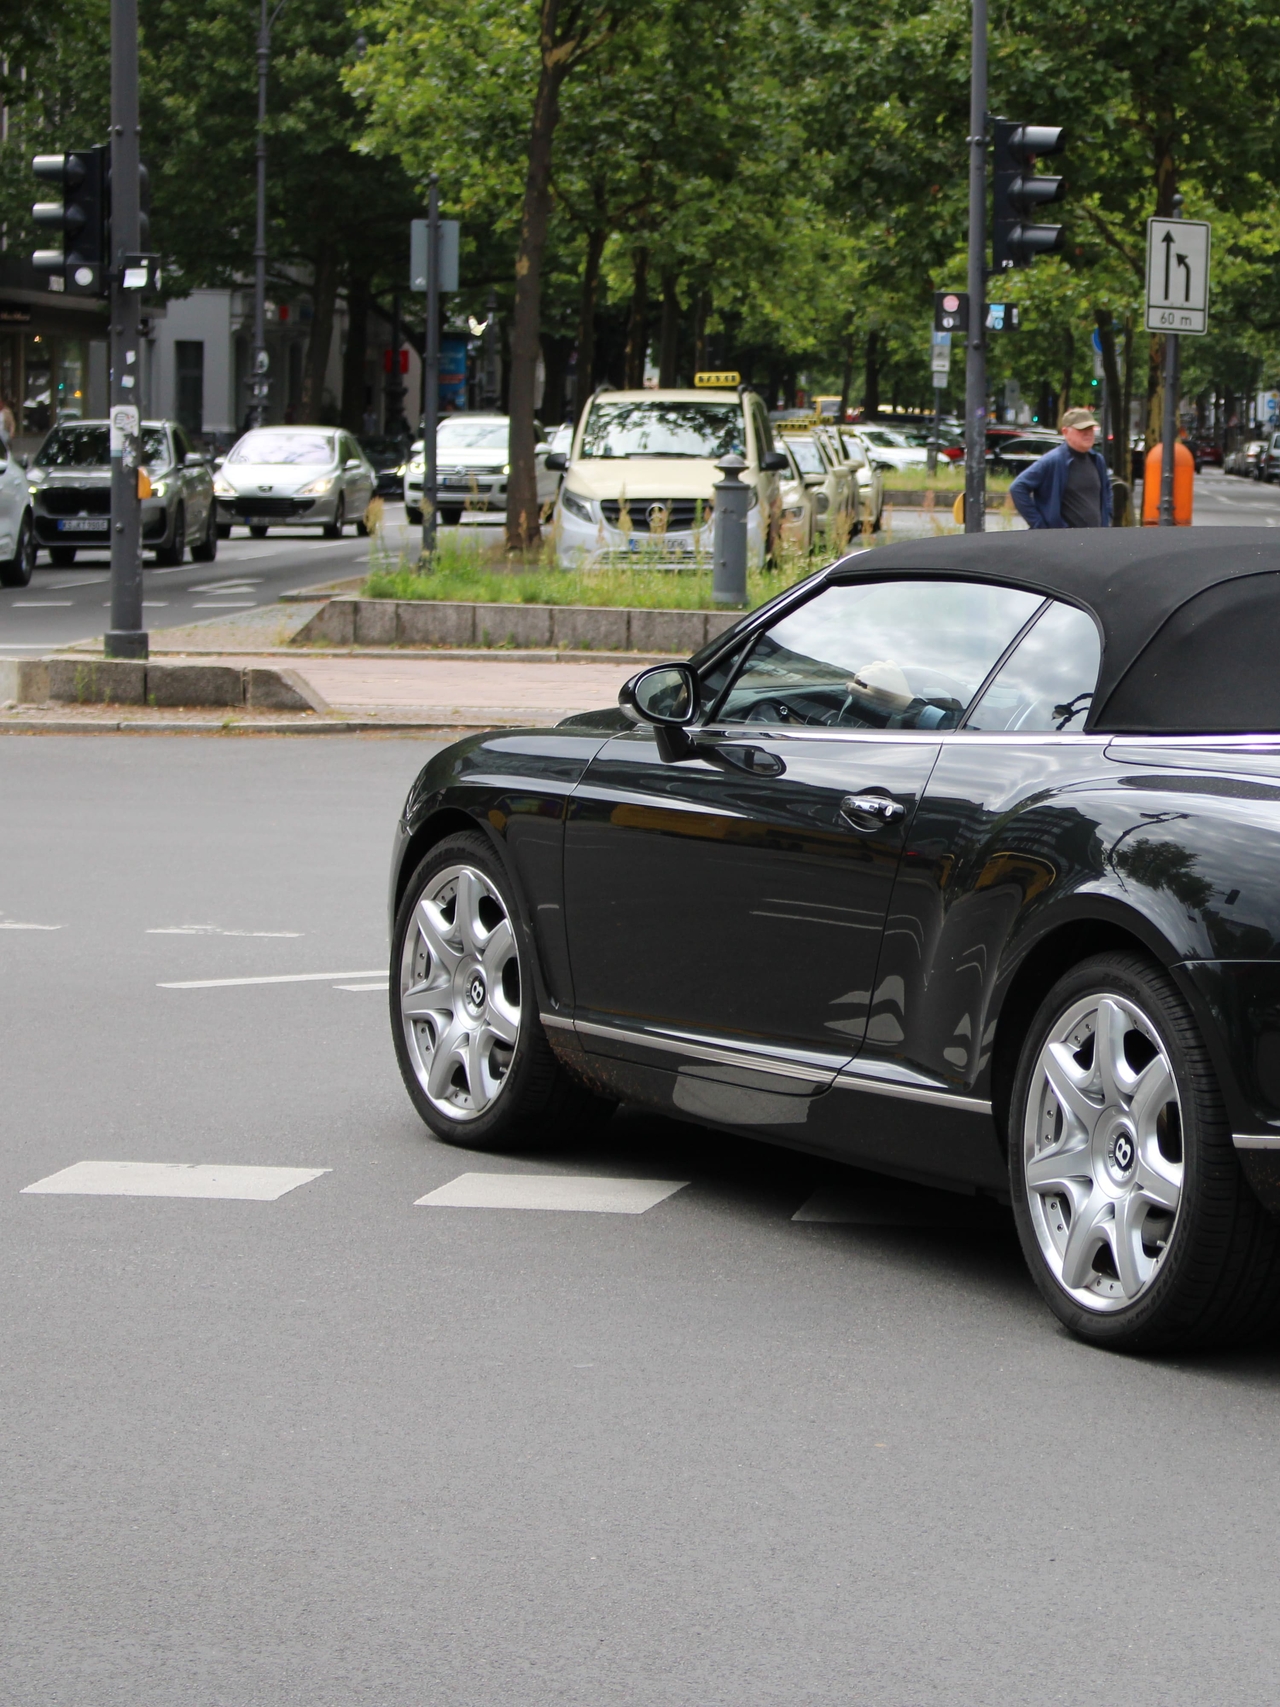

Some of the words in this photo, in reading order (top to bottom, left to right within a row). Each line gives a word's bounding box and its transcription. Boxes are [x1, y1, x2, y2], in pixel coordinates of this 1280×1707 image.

[1002, 260, 1014, 268] F3
[1160, 311, 1175, 325] 60
[1180, 316, 1192, 326] m
[1115, 1138, 1131, 1167] B
